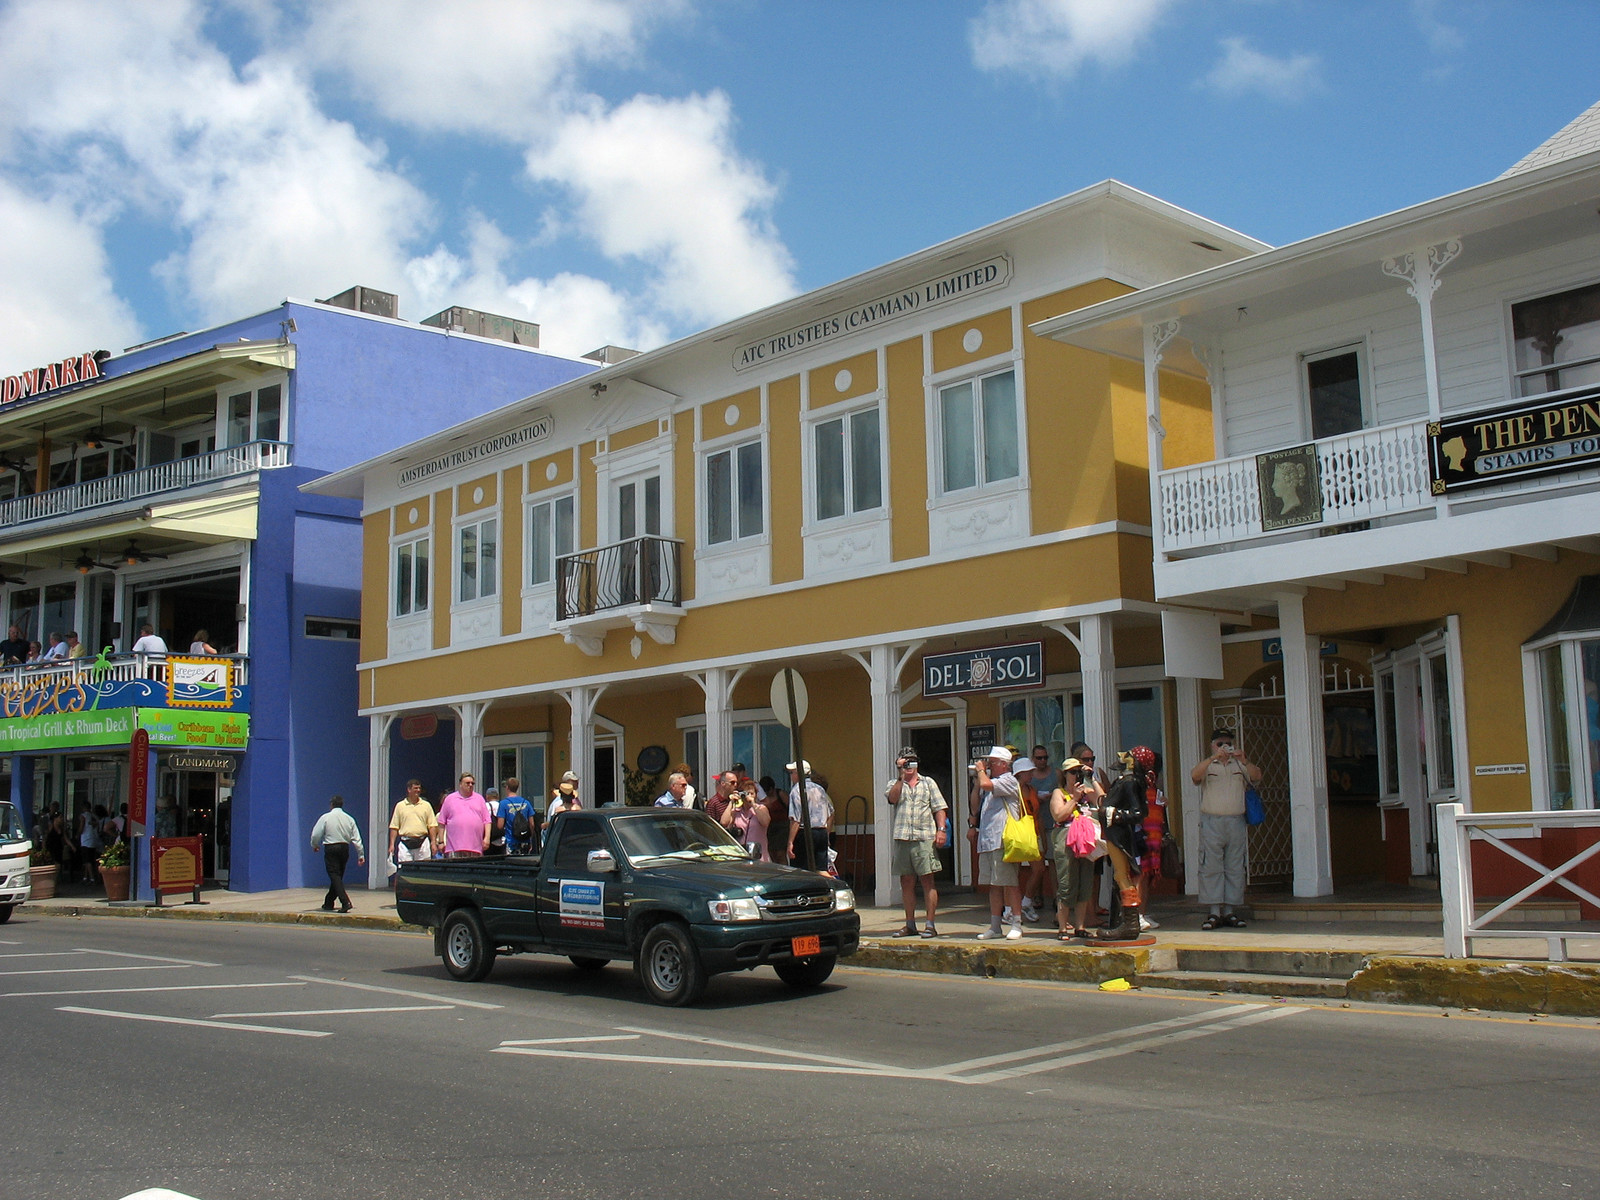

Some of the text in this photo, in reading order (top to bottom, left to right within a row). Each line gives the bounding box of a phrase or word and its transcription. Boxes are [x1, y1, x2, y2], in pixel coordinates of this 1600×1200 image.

[740, 264, 997, 365] ATC TRUSTEES (CAYMAN) LIMITED
[0, 349, 100, 404] DMARK
[1474, 414, 1536, 452] THE
[400, 422, 547, 485] AMSTERDAM TRUST CORPORATION
[1269, 449, 1303, 460] POSTAGE
[1483, 446, 1555, 471] STAMPS
[1287, 514, 1312, 524] PENNY
[929, 655, 1036, 689] DEL SOL
[8, 723, 41, 742] Tropical
[43, 721, 63, 737] Grill
[65, 720, 75, 735] &
[77, 719, 103, 734] Rhum
[106, 716, 128, 733] Deck
[178, 722, 215, 733] Caribbean
[136, 735, 146, 818] CUBAN CIGARS
[176, 758, 229, 769] LANDMARK
